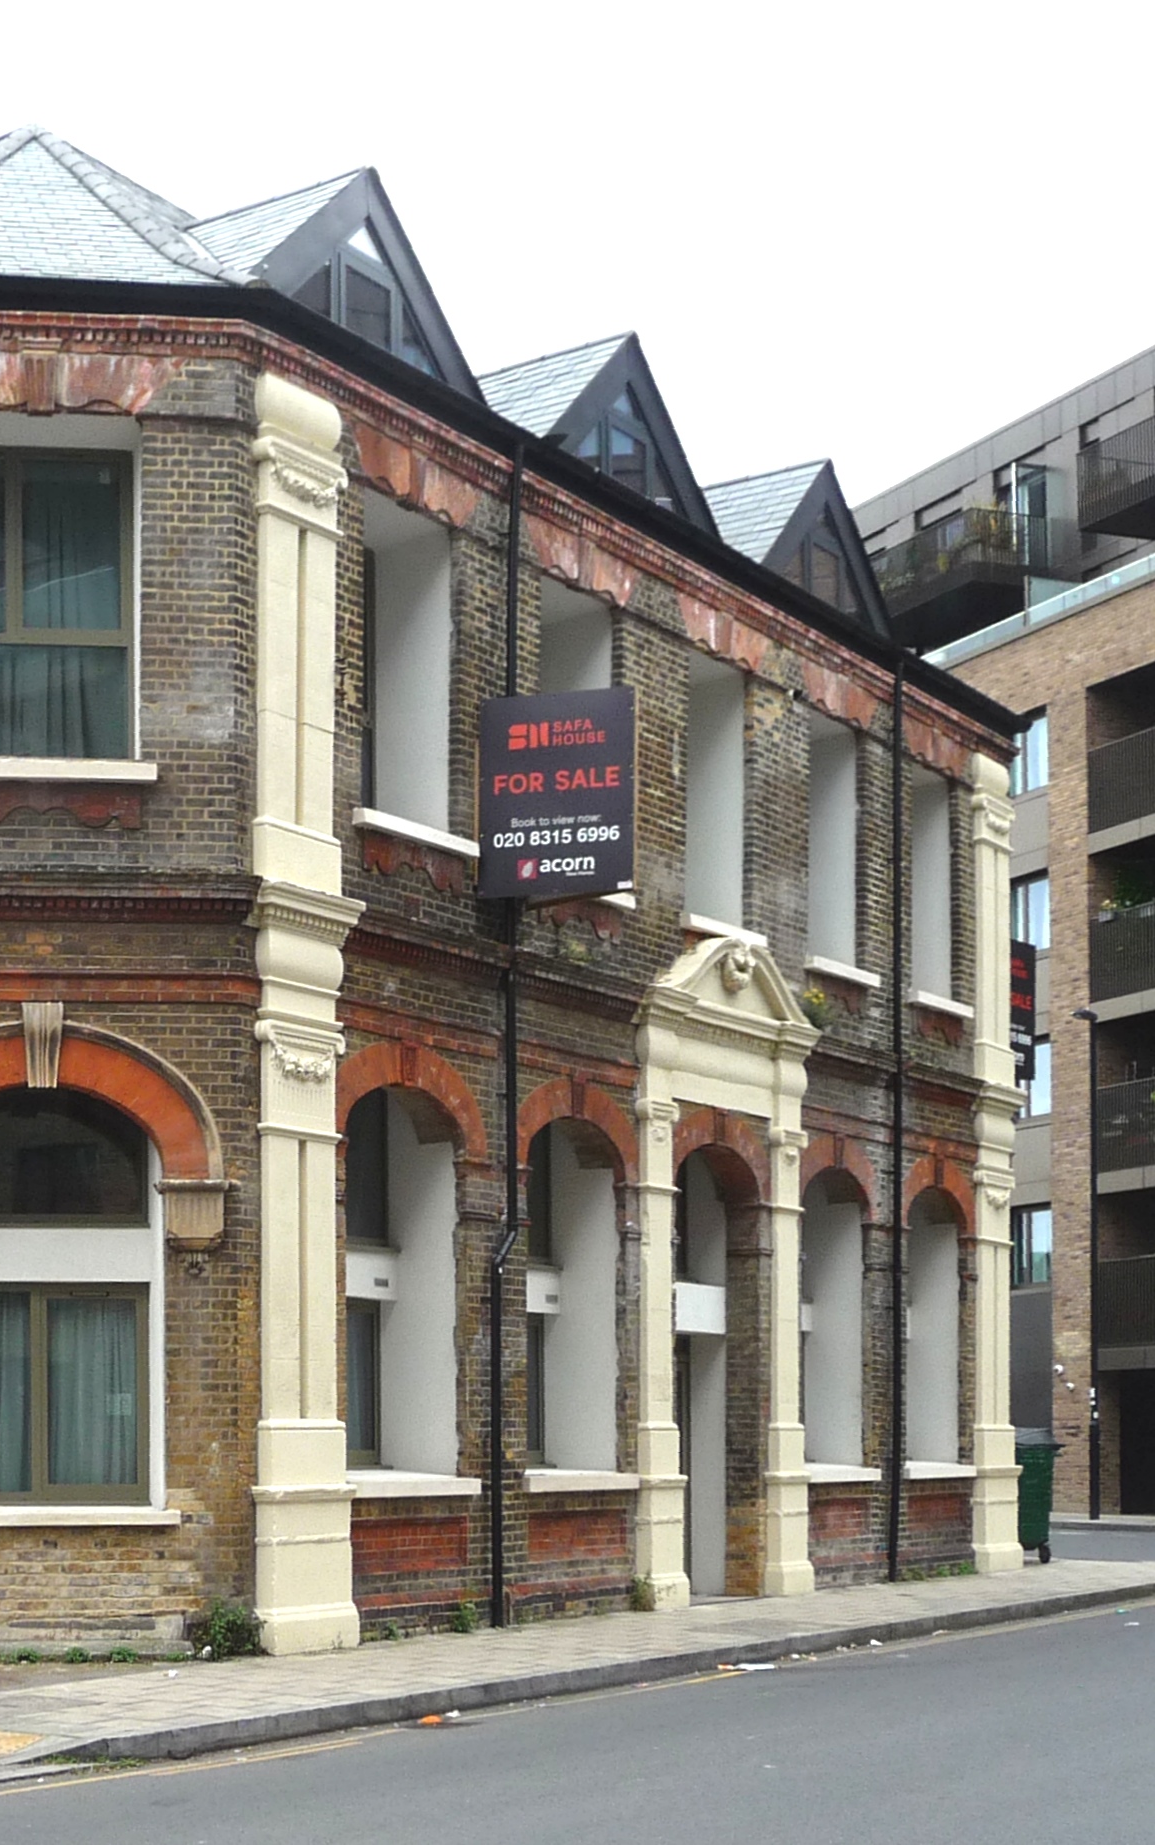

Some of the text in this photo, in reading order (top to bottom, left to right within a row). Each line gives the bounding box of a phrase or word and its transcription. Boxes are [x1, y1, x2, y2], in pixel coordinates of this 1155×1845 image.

[554, 719, 593, 732] SAFA
[552, 732, 606, 746] HOUSE
[493, 766, 620, 795] FOR SALE
[510, 817, 537, 828] Book
[538, 816, 550, 827] to
[551, 815, 576, 826] view
[493, 825, 620, 848] 020 8315 6996
[539, 856, 595, 873] acorn
